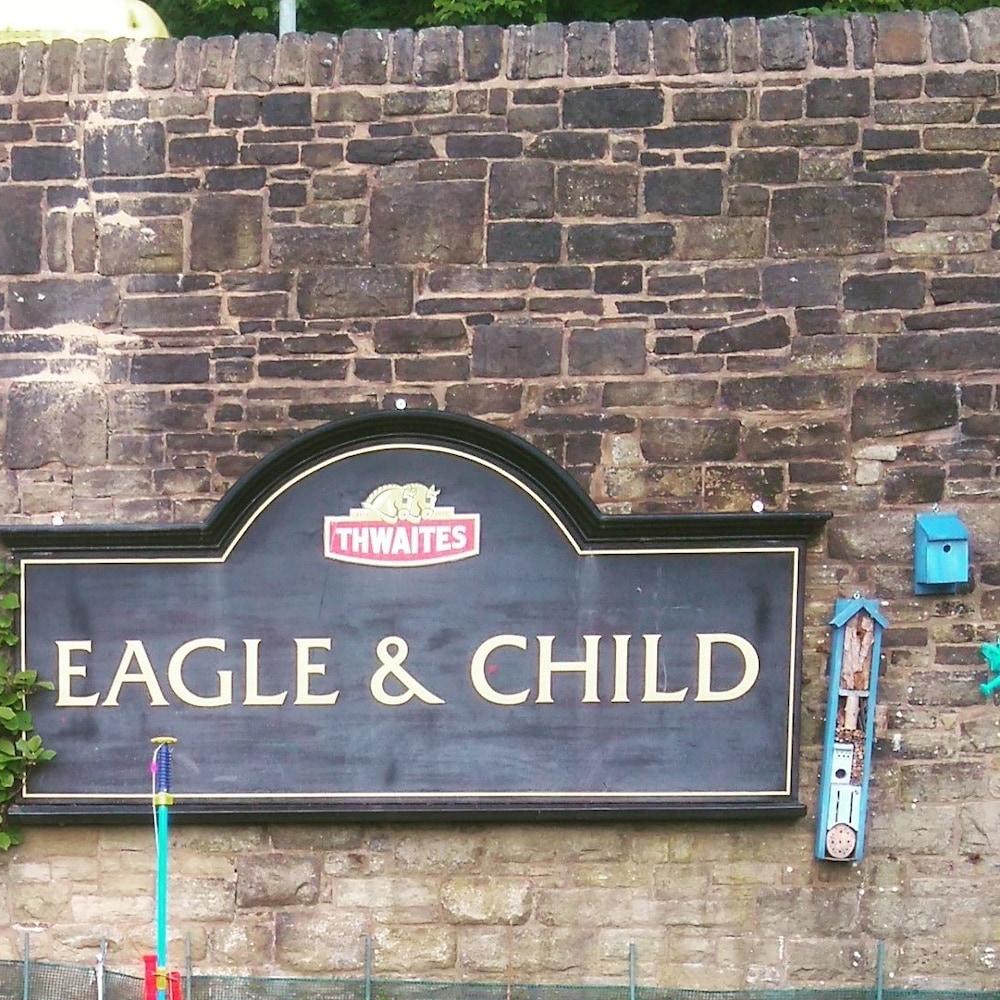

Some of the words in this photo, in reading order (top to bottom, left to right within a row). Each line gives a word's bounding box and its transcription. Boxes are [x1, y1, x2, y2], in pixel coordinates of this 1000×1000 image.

[335, 525, 467, 555] THWAITES
[54, 636, 340, 709] EAGLE
[369, 634, 446, 705] &
[469, 632, 761, 705] CHILD
